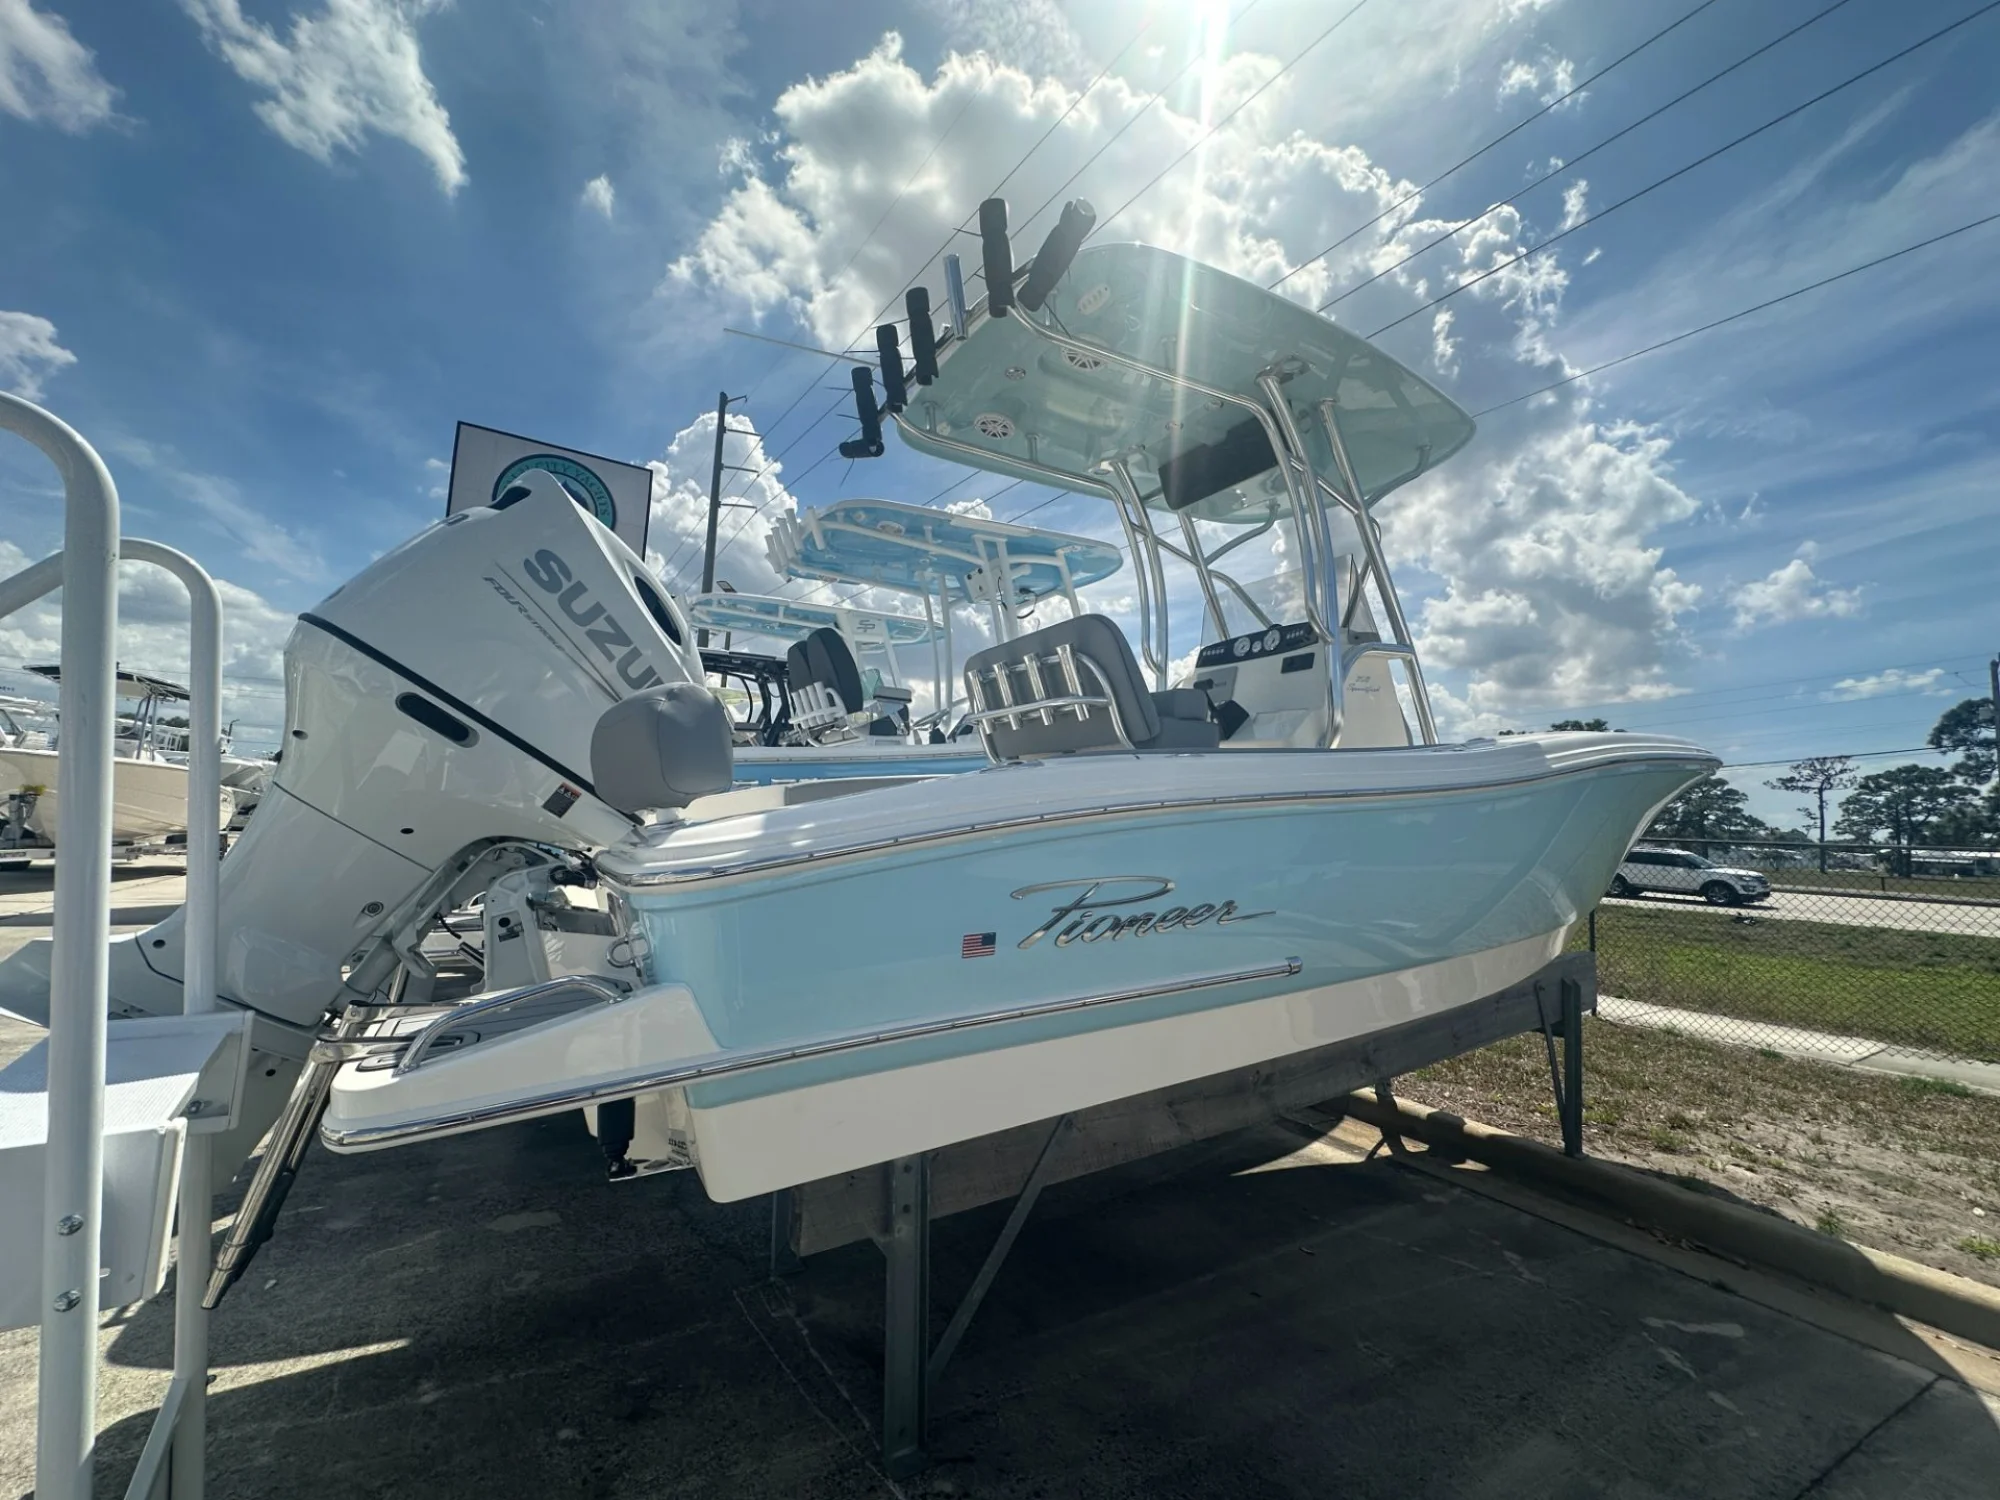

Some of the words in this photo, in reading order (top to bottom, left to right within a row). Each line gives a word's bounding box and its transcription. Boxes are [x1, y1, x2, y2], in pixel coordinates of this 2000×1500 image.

[575, 466, 610, 517] YACHTS
[524, 549, 665, 690] SUZU
[1010, 875, 1277, 950] Pioneer
